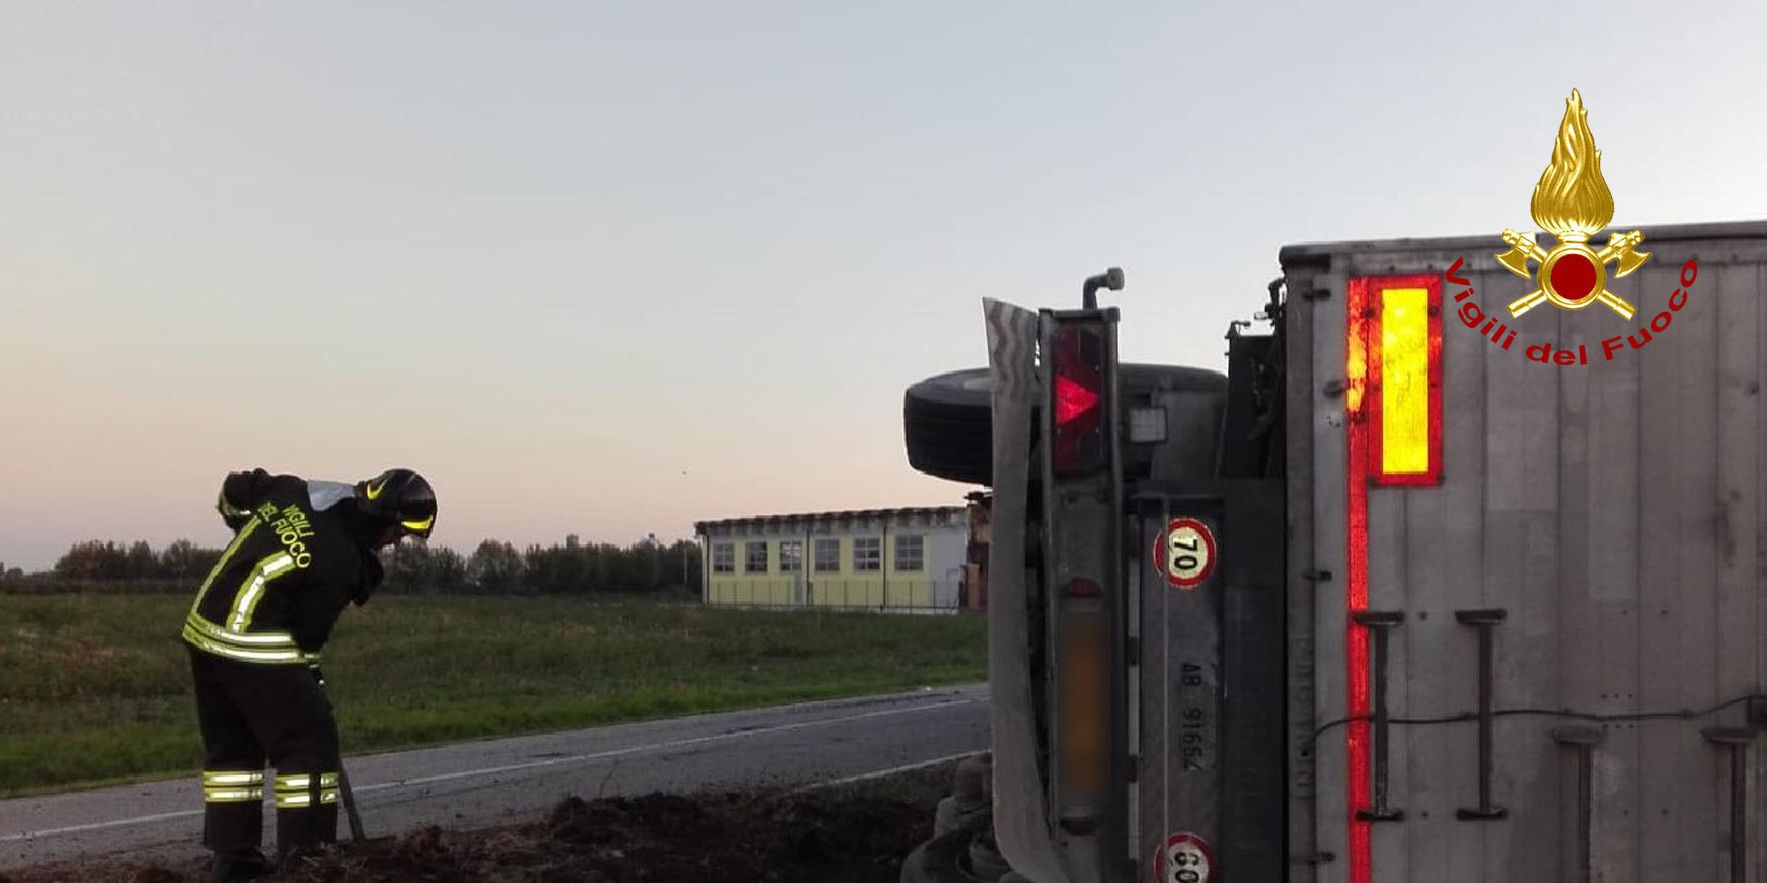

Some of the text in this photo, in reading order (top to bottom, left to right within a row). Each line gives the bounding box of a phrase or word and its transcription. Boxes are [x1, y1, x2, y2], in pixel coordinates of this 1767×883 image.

[270, 518, 312, 568] FUOCO
[1174, 539, 1198, 570] 70
[1181, 663, 1202, 687] AB
